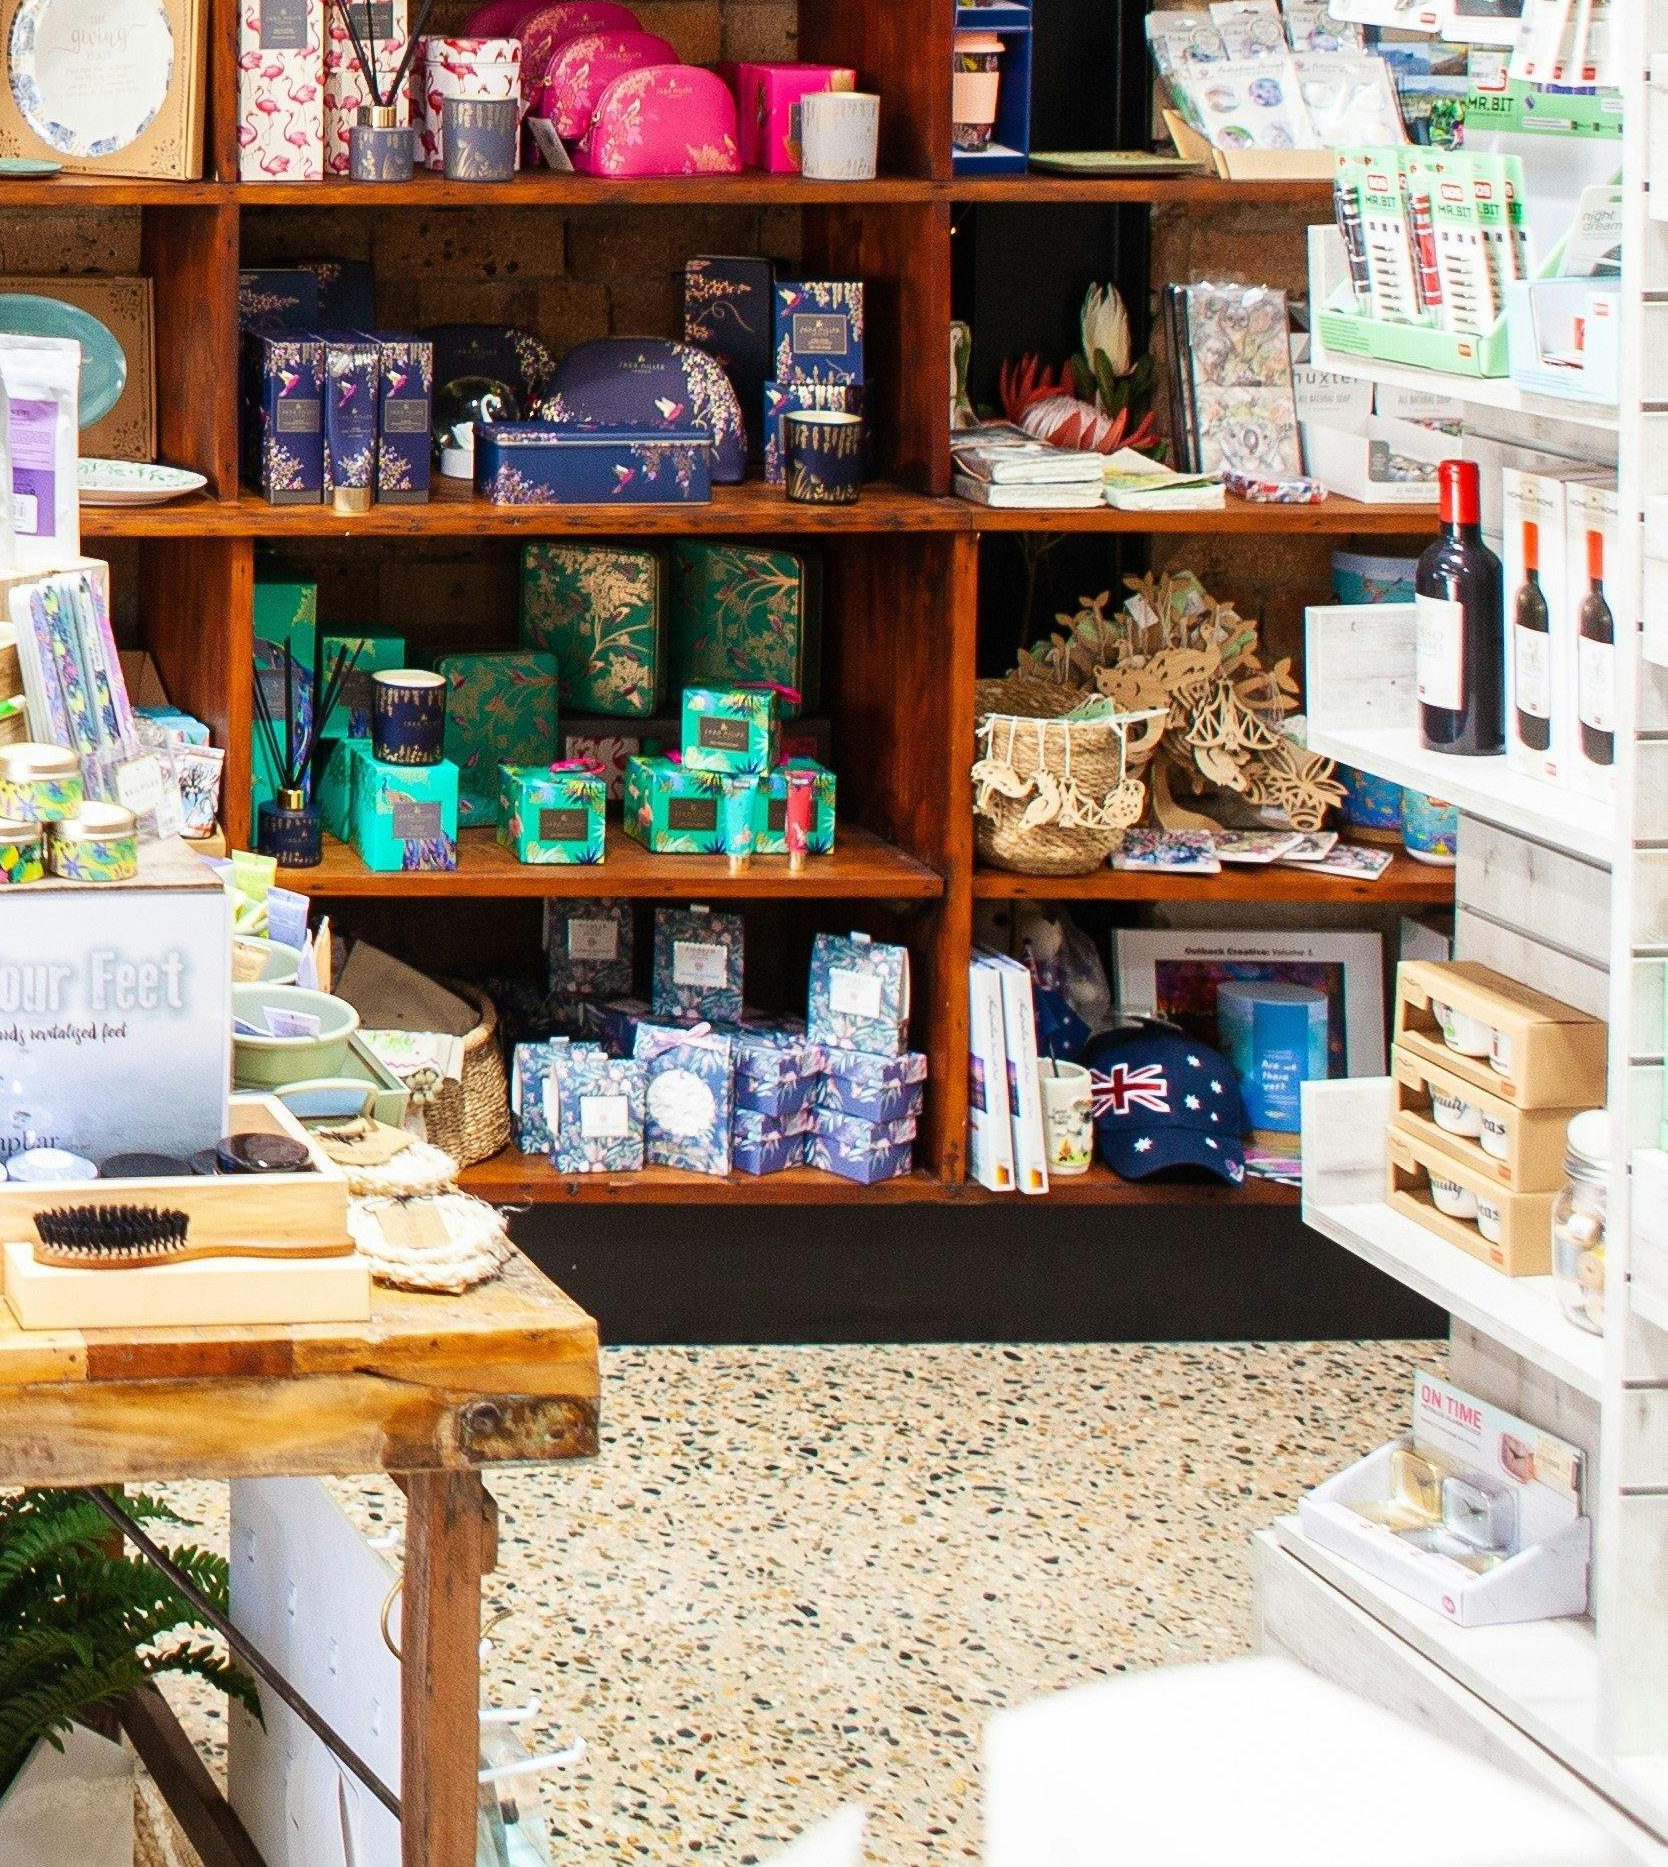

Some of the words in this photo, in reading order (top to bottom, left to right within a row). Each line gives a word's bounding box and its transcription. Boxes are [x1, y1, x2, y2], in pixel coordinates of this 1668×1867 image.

[1468, 96, 1515, 113] MR.BIT
[1365, 196, 1396, 209] MR.BIT
[91, 948, 185, 1012] Feet
[102, 1022, 127, 1040] feet
[1421, 1384, 1442, 1409] ON
[1446, 1395, 1482, 1431] TIME
